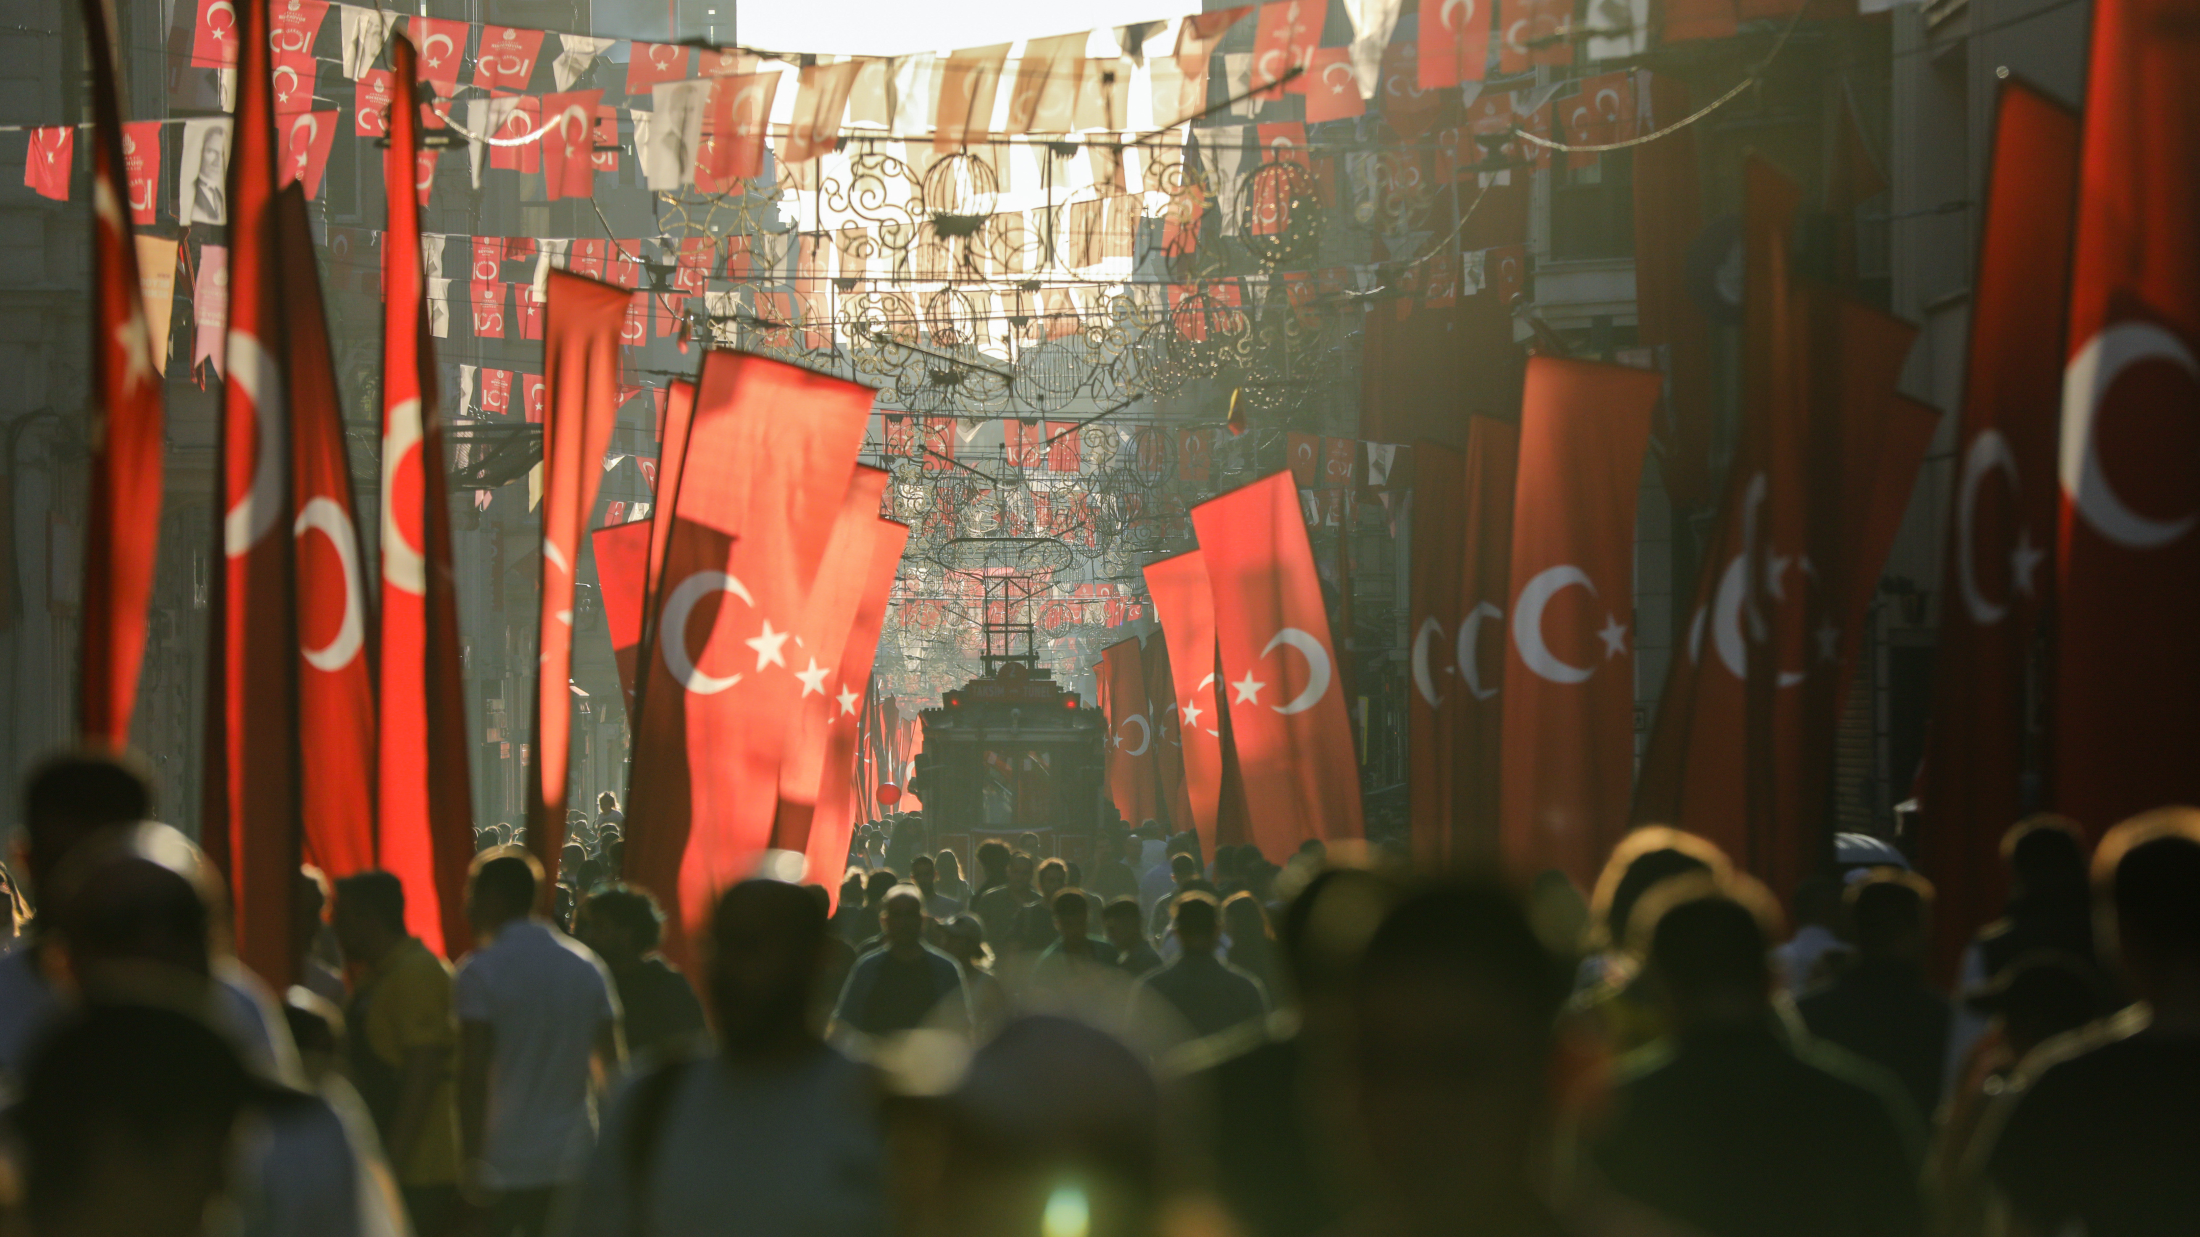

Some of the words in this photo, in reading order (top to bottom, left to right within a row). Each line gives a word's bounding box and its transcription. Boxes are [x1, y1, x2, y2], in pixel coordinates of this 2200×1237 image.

[1009, 663, 1016, 678] 2
[972, 683, 1005, 697] TAKSİM
[1023, 683, 1051, 698] TÜNEL
